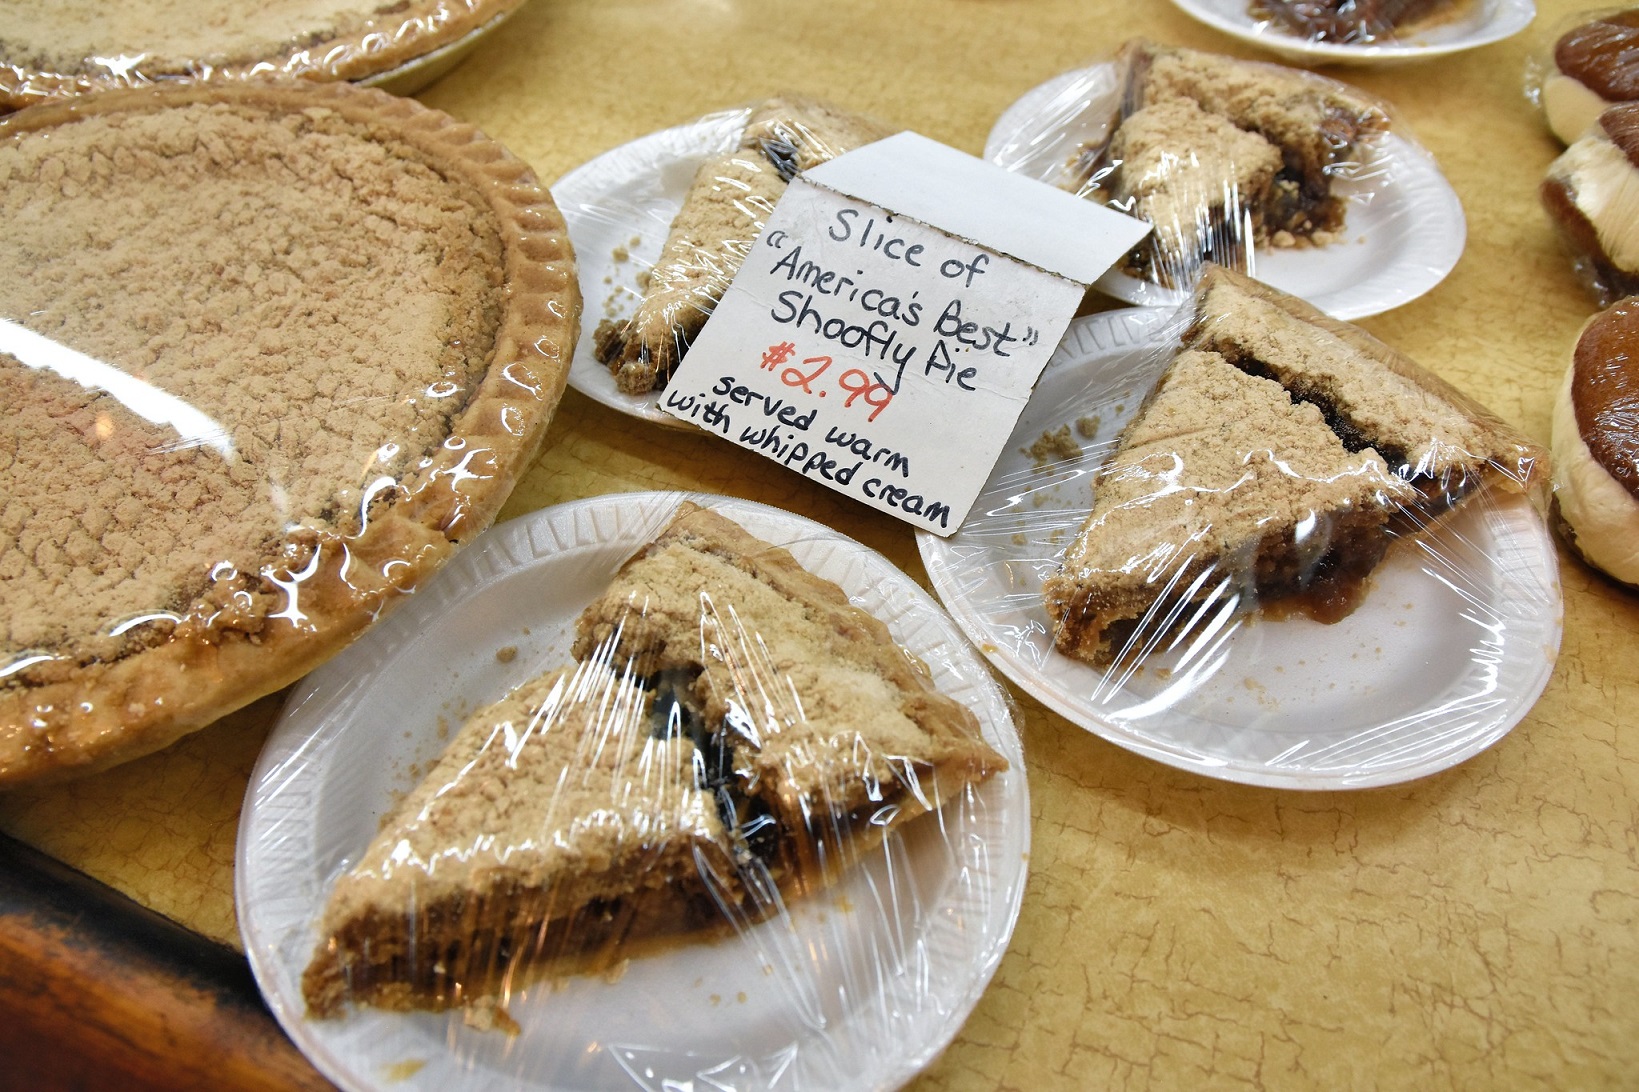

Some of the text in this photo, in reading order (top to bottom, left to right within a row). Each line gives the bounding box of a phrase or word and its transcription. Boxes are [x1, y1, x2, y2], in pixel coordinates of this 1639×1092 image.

[829, 208, 990, 288] Slice of
[760, 340, 894, 423] $2.99
[770, 290, 978, 394] Shoofly Pie
[666, 388, 951, 527] with whipped cream
[712, 374, 910, 478] served warm
